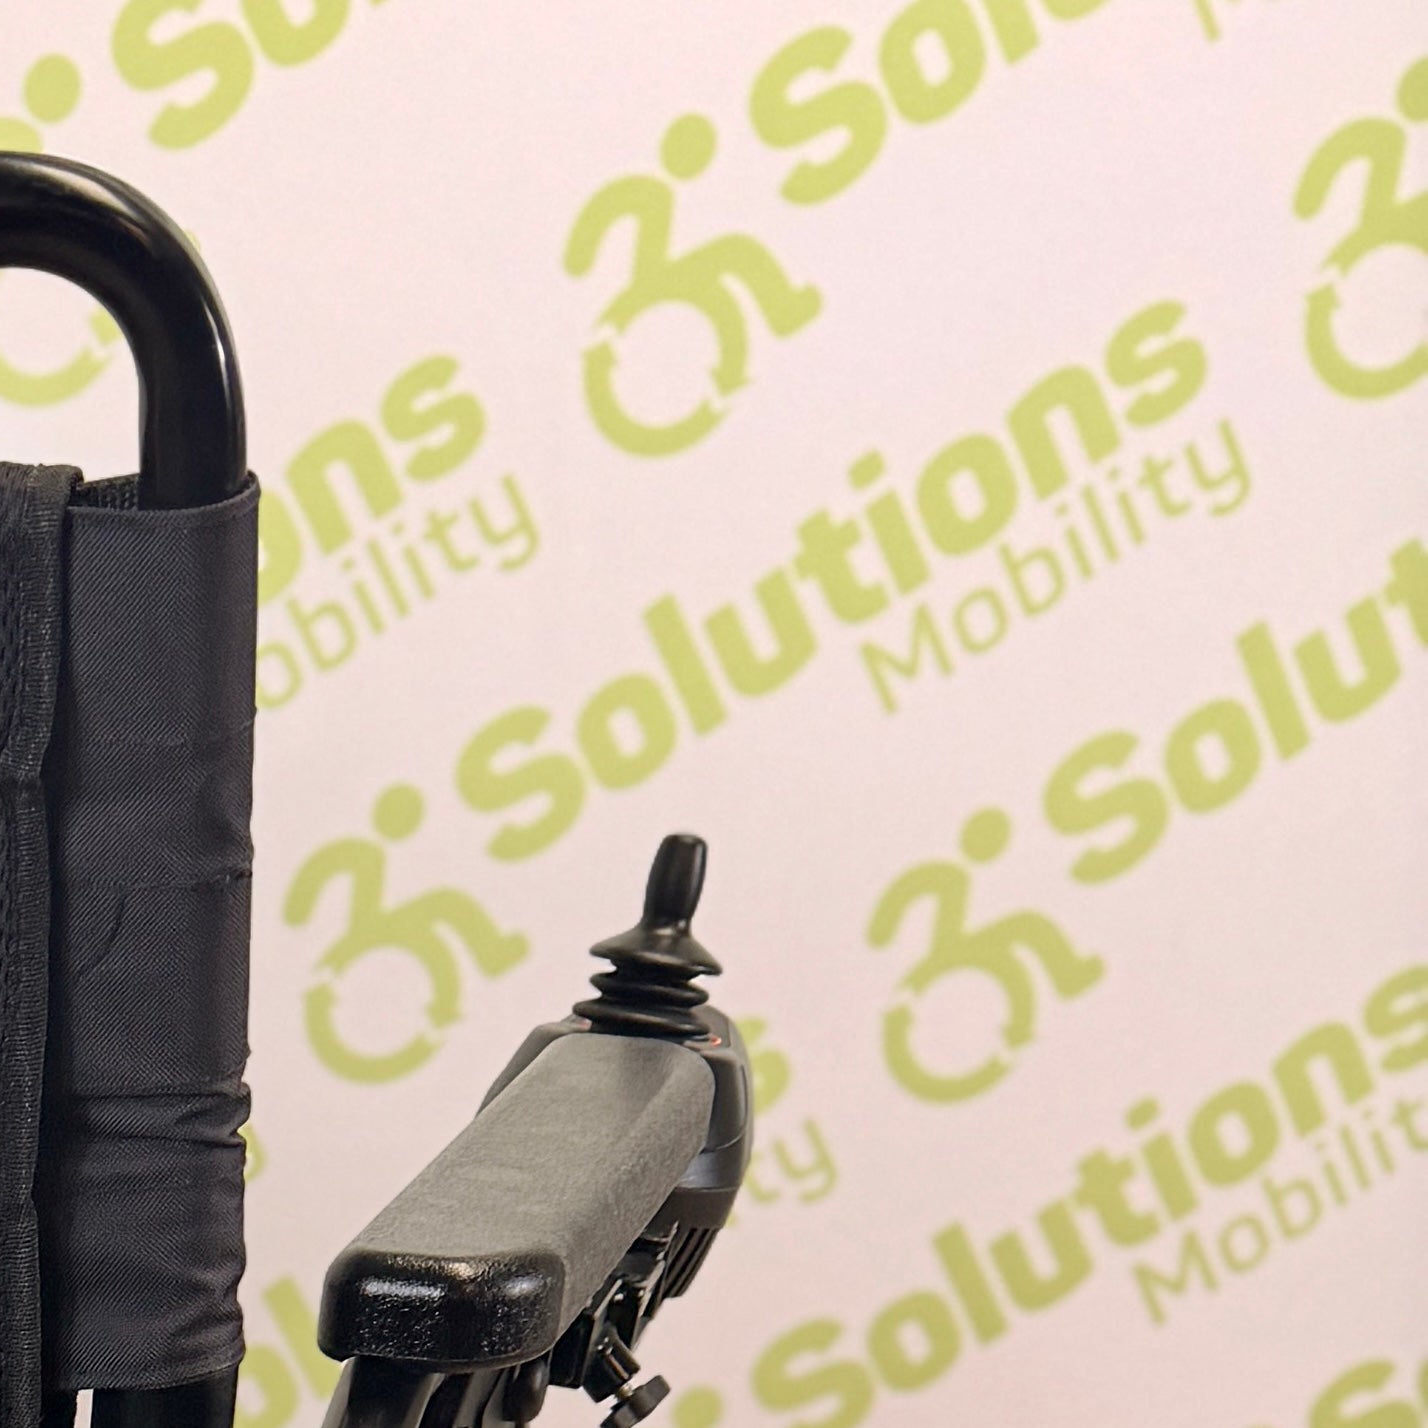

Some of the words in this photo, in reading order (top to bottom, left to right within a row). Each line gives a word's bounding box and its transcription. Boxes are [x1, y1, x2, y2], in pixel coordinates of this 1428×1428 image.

[256, 473, 542, 710] obility
[454, 299, 1209, 866] Solutions
[859, 418, 1252, 716] Mobility
